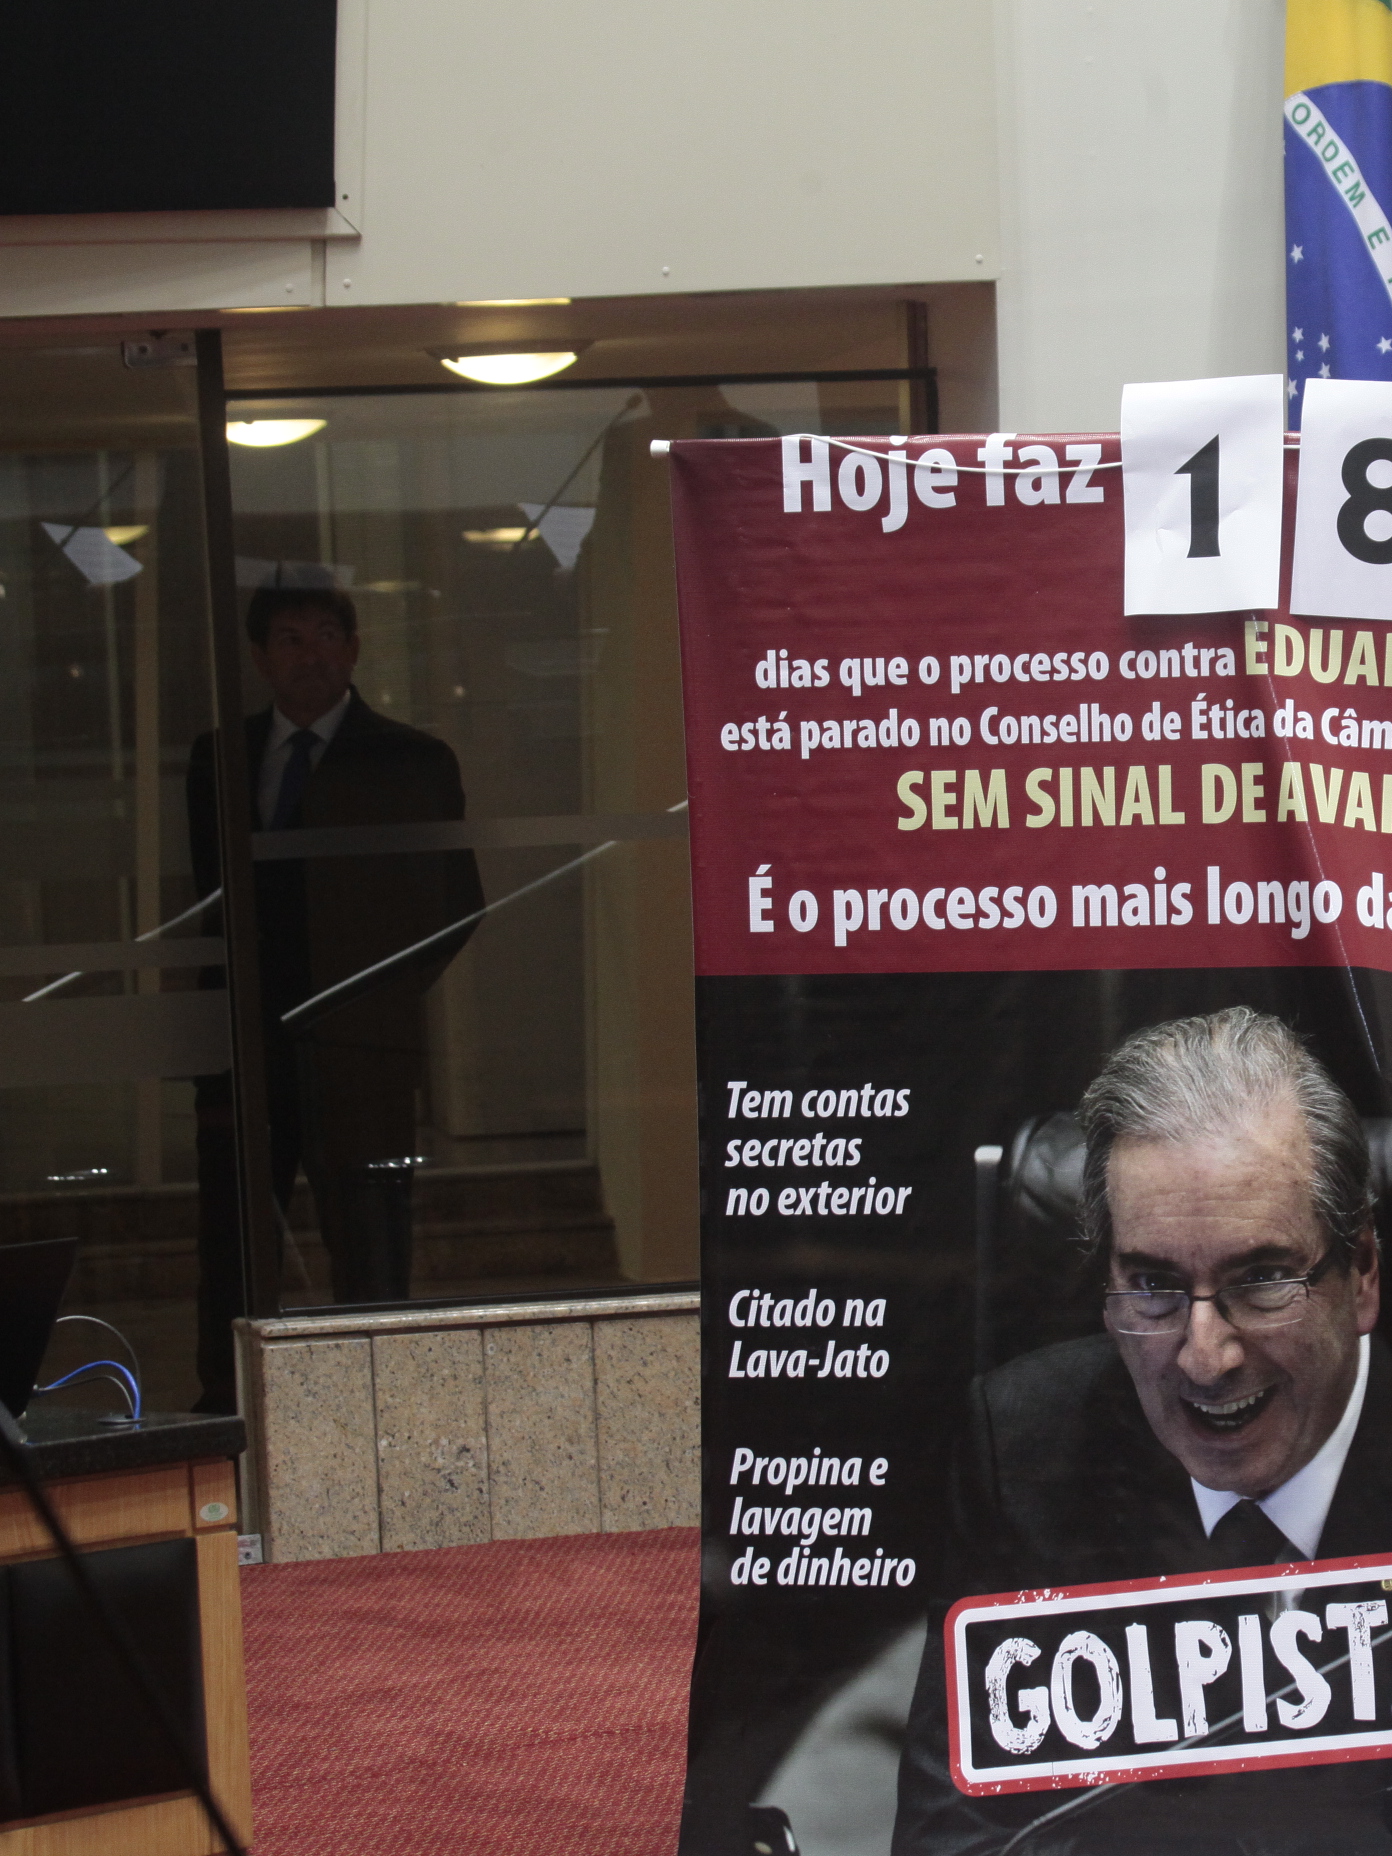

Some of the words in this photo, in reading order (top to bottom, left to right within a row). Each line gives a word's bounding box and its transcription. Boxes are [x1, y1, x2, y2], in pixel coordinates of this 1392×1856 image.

[1291, 101, 1366, 208] ORDEM
[1367, 226, 1390, 250] E
[782, 435, 958, 533] Hoje
[977, 433, 1105, 506] faz
[755, 649, 830, 689] dias
[839, 655, 909, 697] que
[918, 655, 940, 685] o
[950, 649, 1109, 694] processo
[1119, 641, 1236, 679] contra
[720, 712, 791, 751] está
[801, 708, 921, 759] parado
[929, 718, 972, 746] no
[980, 703, 1134, 745] Conselho
[1141, 701, 1181, 740] de
[1191, 693, 1266, 740] Ética
[1273, 698, 1315, 740] da
[897, 769, 1010, 831] SEM
[1025, 764, 1186, 829] SINAL
[1202, 762, 1267, 825] DE
[749, 864, 775, 933] É
[788, 890, 819, 933] o
[833, 886, 1058, 947] processo
[1072, 866, 1194, 928] mais
[1207, 865, 1343, 940] longo
[726, 1081, 794, 1119] Tem
[801, 1082, 911, 1118] contas
[724, 1132, 863, 1168] secretas
[725, 1187, 770, 1216] no
[777, 1176, 912, 1216] exterior
[728, 1288, 836, 1328] Citado
[842, 1297, 887, 1327] na
[728, 1340, 890, 1378] Lava-Jato
[729, 1447, 863, 1495] Propina
[869, 1457, 889, 1486] e
[729, 1496, 873, 1546] lavagem
[730, 1546, 771, 1585] de
[776, 1546, 916, 1587] dinheiro
